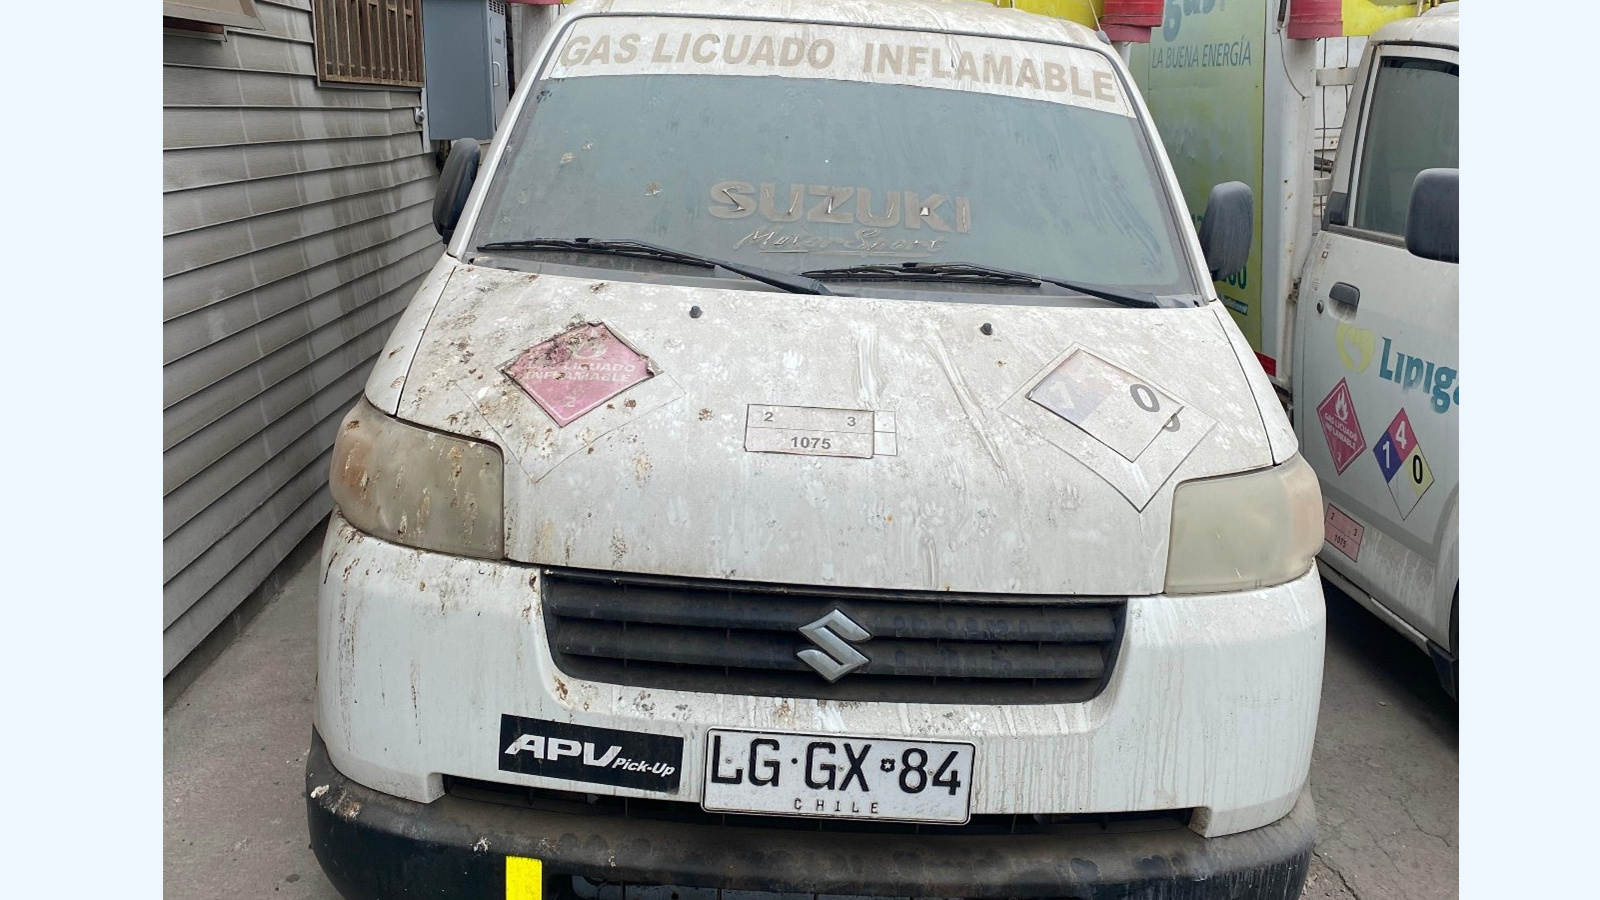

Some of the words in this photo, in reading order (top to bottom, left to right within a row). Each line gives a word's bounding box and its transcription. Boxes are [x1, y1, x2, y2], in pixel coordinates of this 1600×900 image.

[1152, 48, 1164, 68] LA
[1166, 44, 1199, 68] BUENA
[1202, 35, 1251, 67] ENERGÍA
[560, 34, 641, 67] GAS
[651, 33, 836, 69] LICUADO
[863, 42, 1117, 103] INFLAMABLE
[708, 181, 972, 234] SUZUKI
[764, 412, 774, 422] 2
[847, 417, 856, 427] 3
[791, 436, 832, 450] 1075
[1396, 421, 1407, 449] 4
[1383, 441, 1391, 469] 1
[1413, 454, 1423, 484] 0
[1334, 534, 1347, 549] 1075
[504, 733, 623, 767] APV
[613, 757, 677, 778] Pick-Up
[794, 797, 881, 815] CHILE
